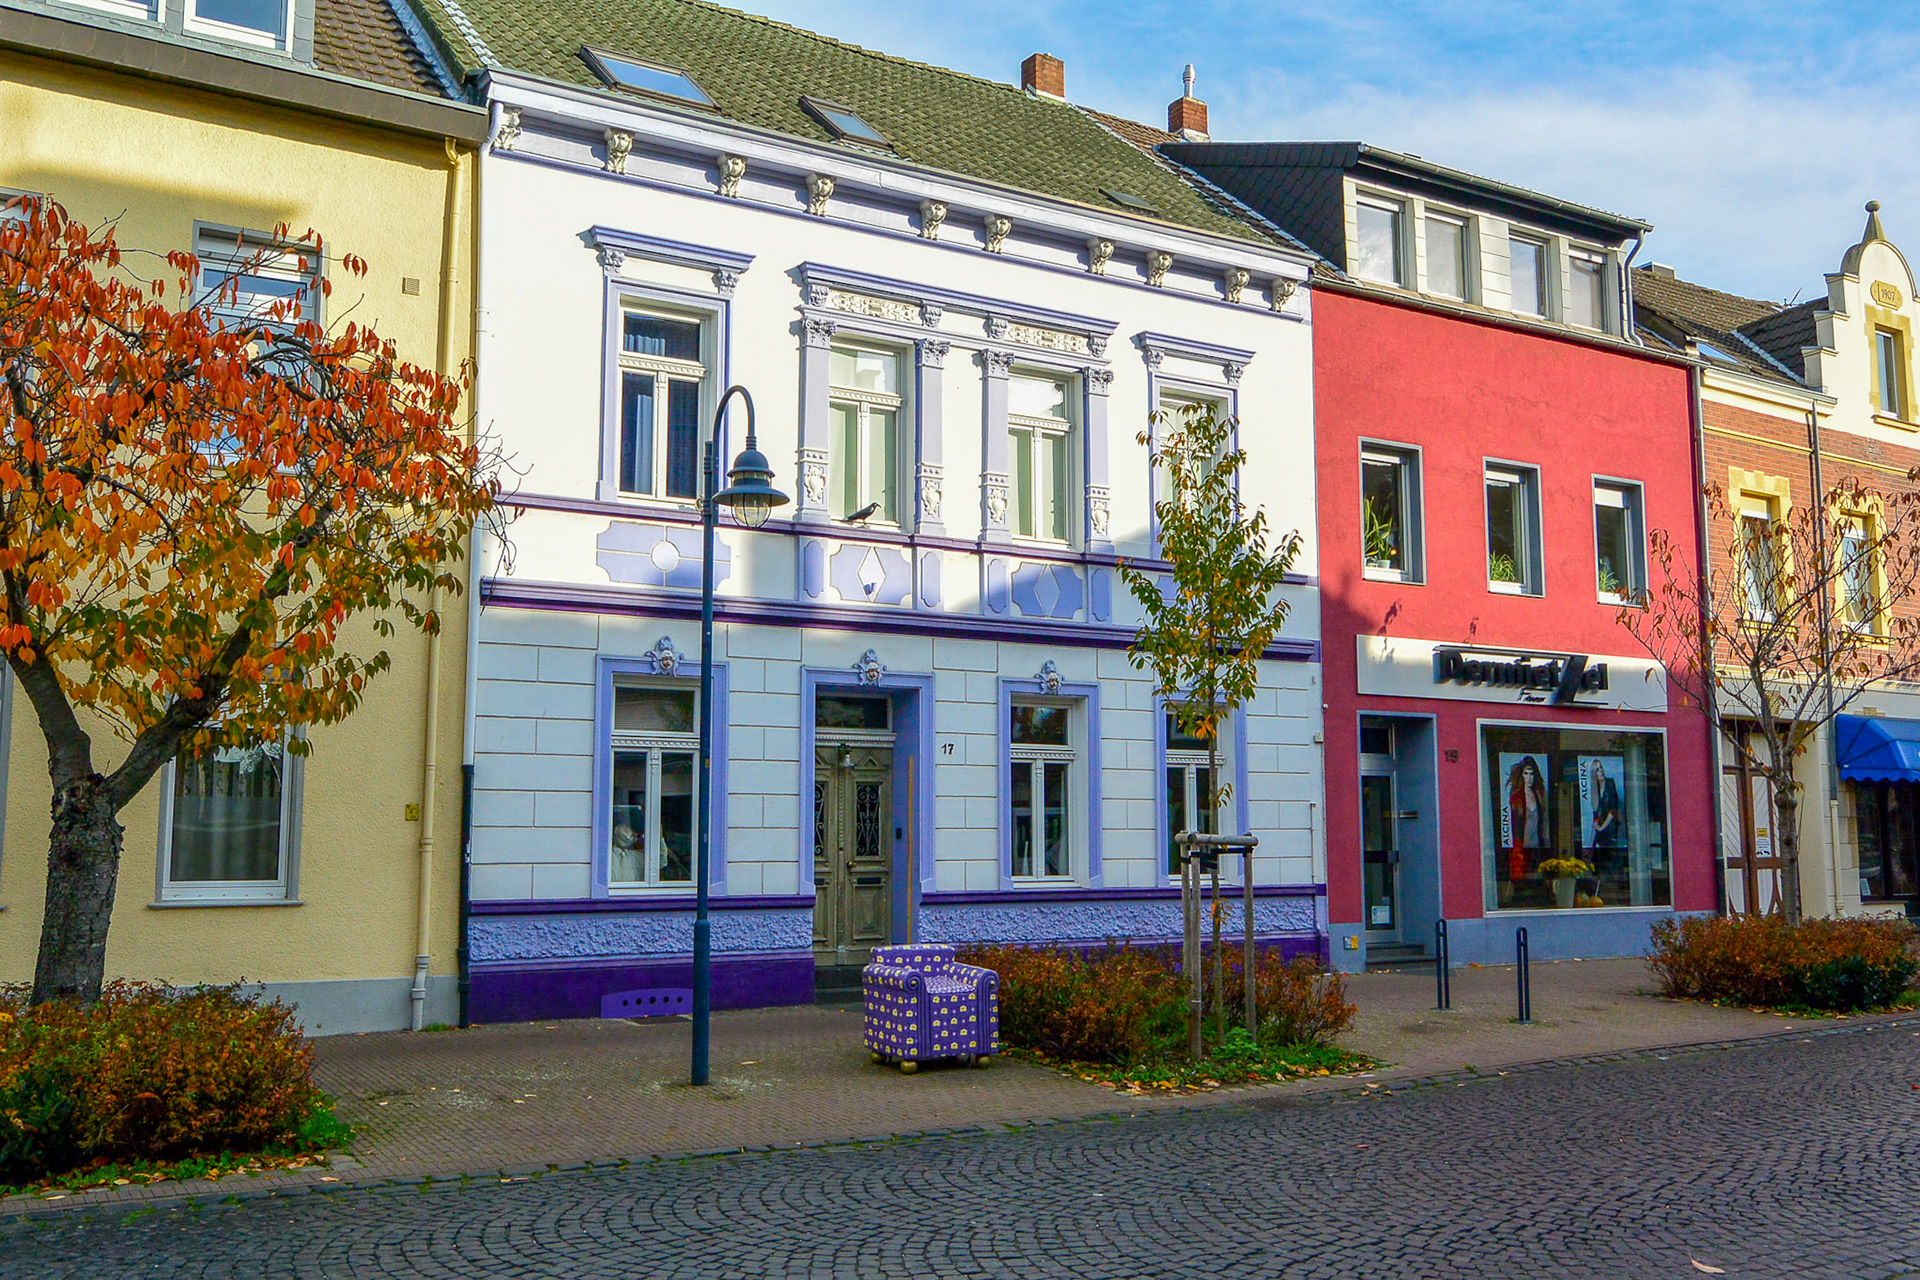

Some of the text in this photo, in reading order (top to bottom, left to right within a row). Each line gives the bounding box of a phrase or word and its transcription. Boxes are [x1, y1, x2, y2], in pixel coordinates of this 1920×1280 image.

[1881, 288, 1896, 301] 1907
[941, 743, 955, 755] 17
[1444, 748, 1459, 763] 19
[1580, 760, 1588, 800] ALCINA
[1502, 806, 1510, 846] ALCINA
